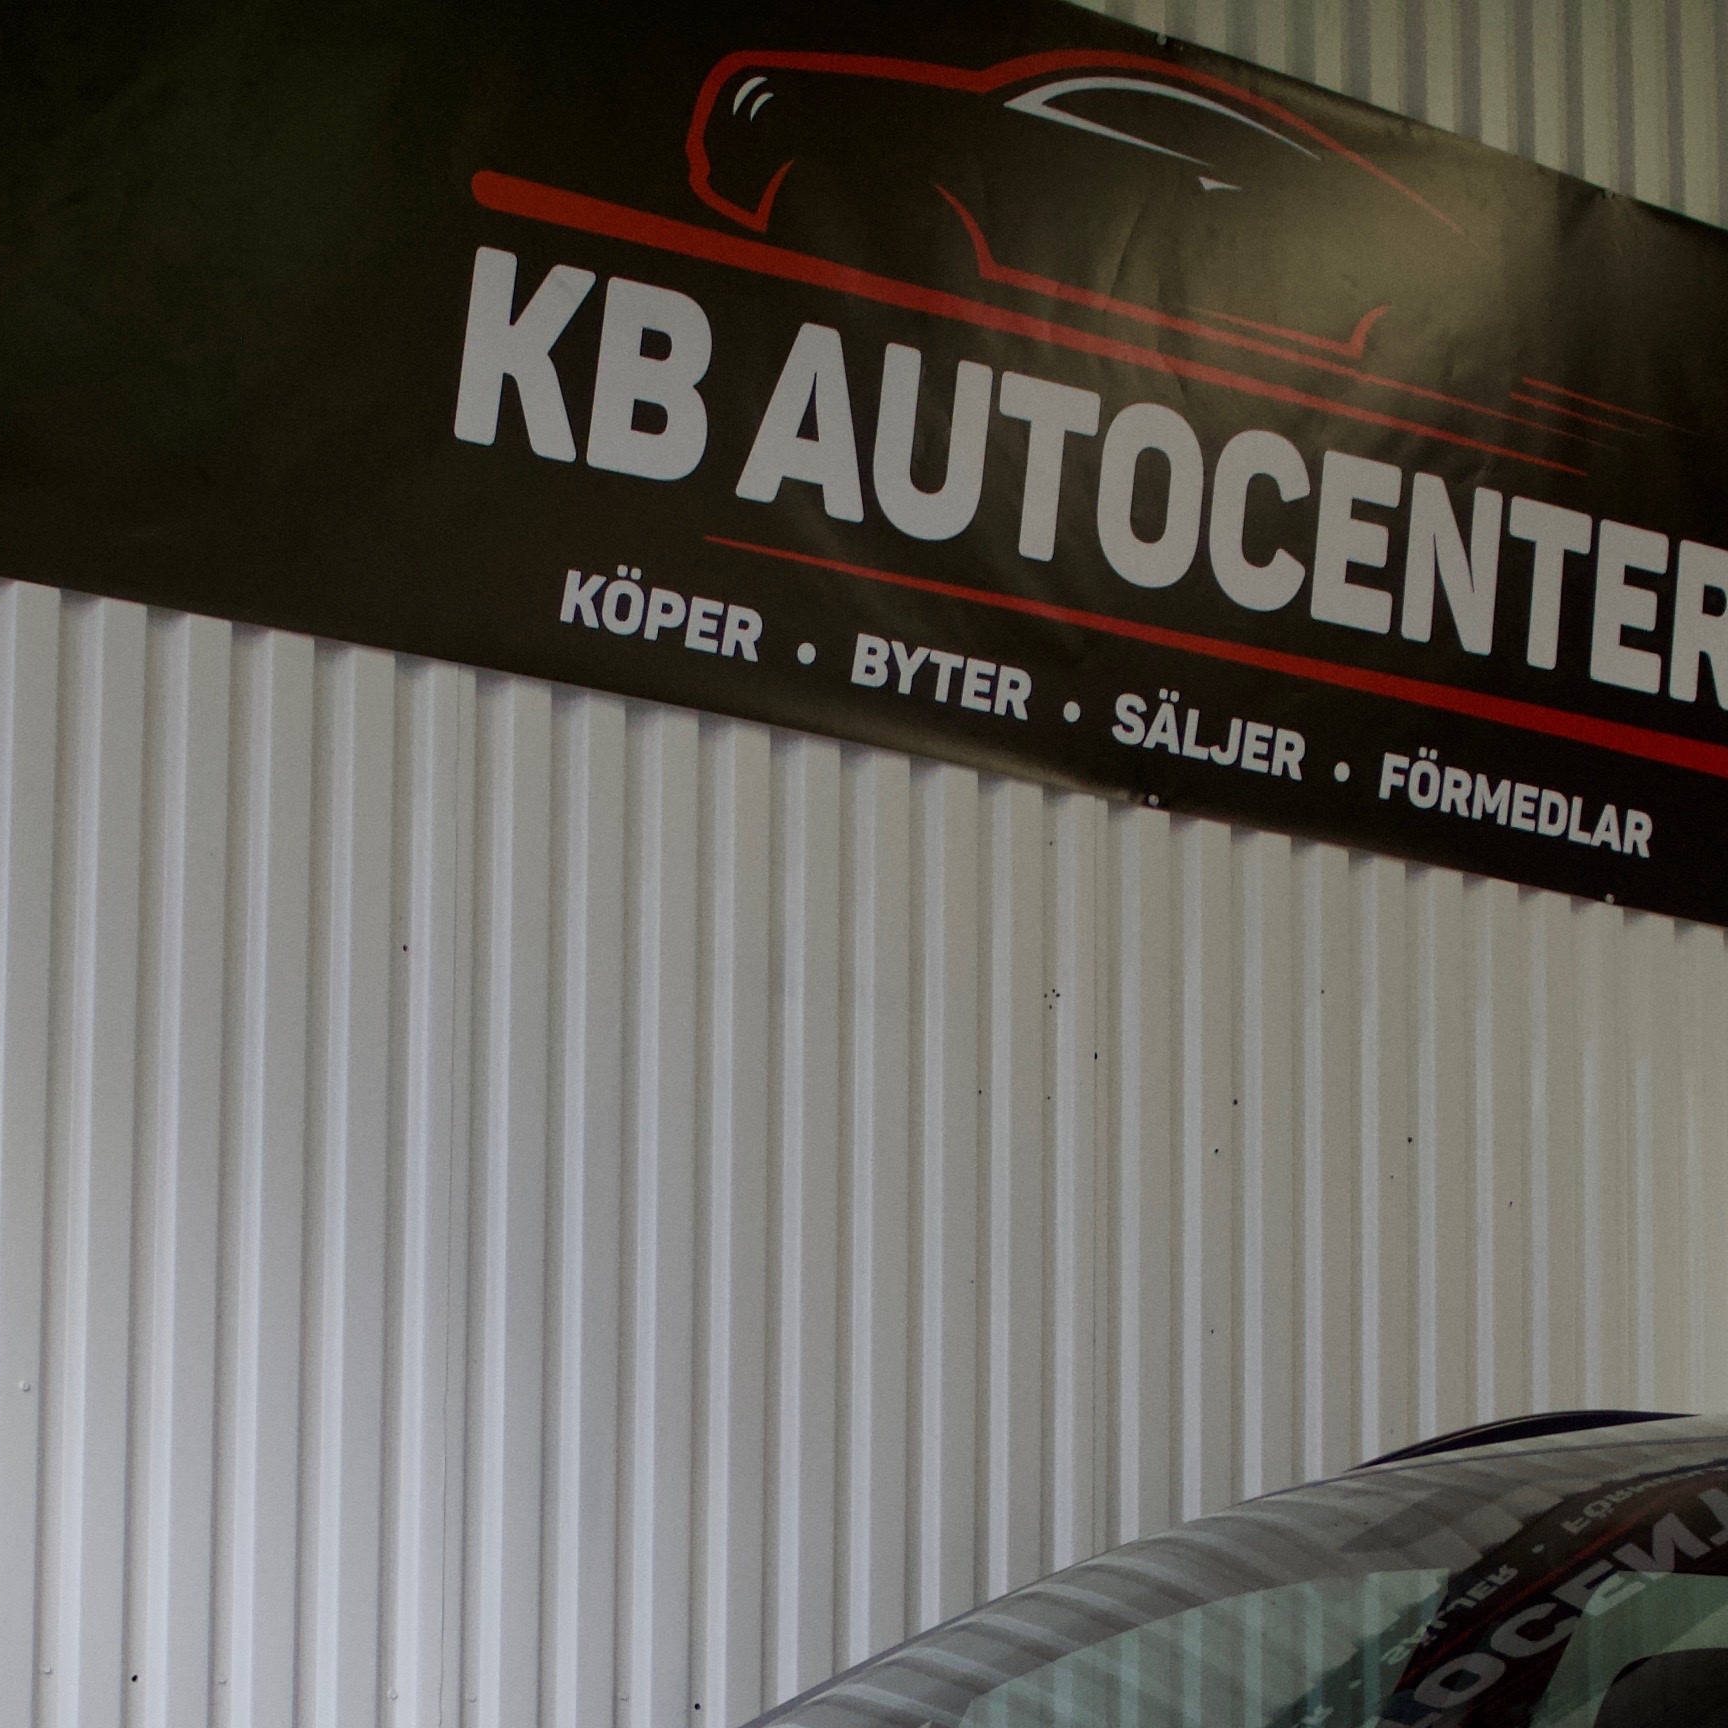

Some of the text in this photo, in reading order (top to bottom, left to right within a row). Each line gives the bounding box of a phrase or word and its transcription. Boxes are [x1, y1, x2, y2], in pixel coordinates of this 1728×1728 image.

[453, 246, 712, 481] KB
[559, 564, 1654, 862] KÖPER BYTER SÄLJER FÖRMEDLAR
